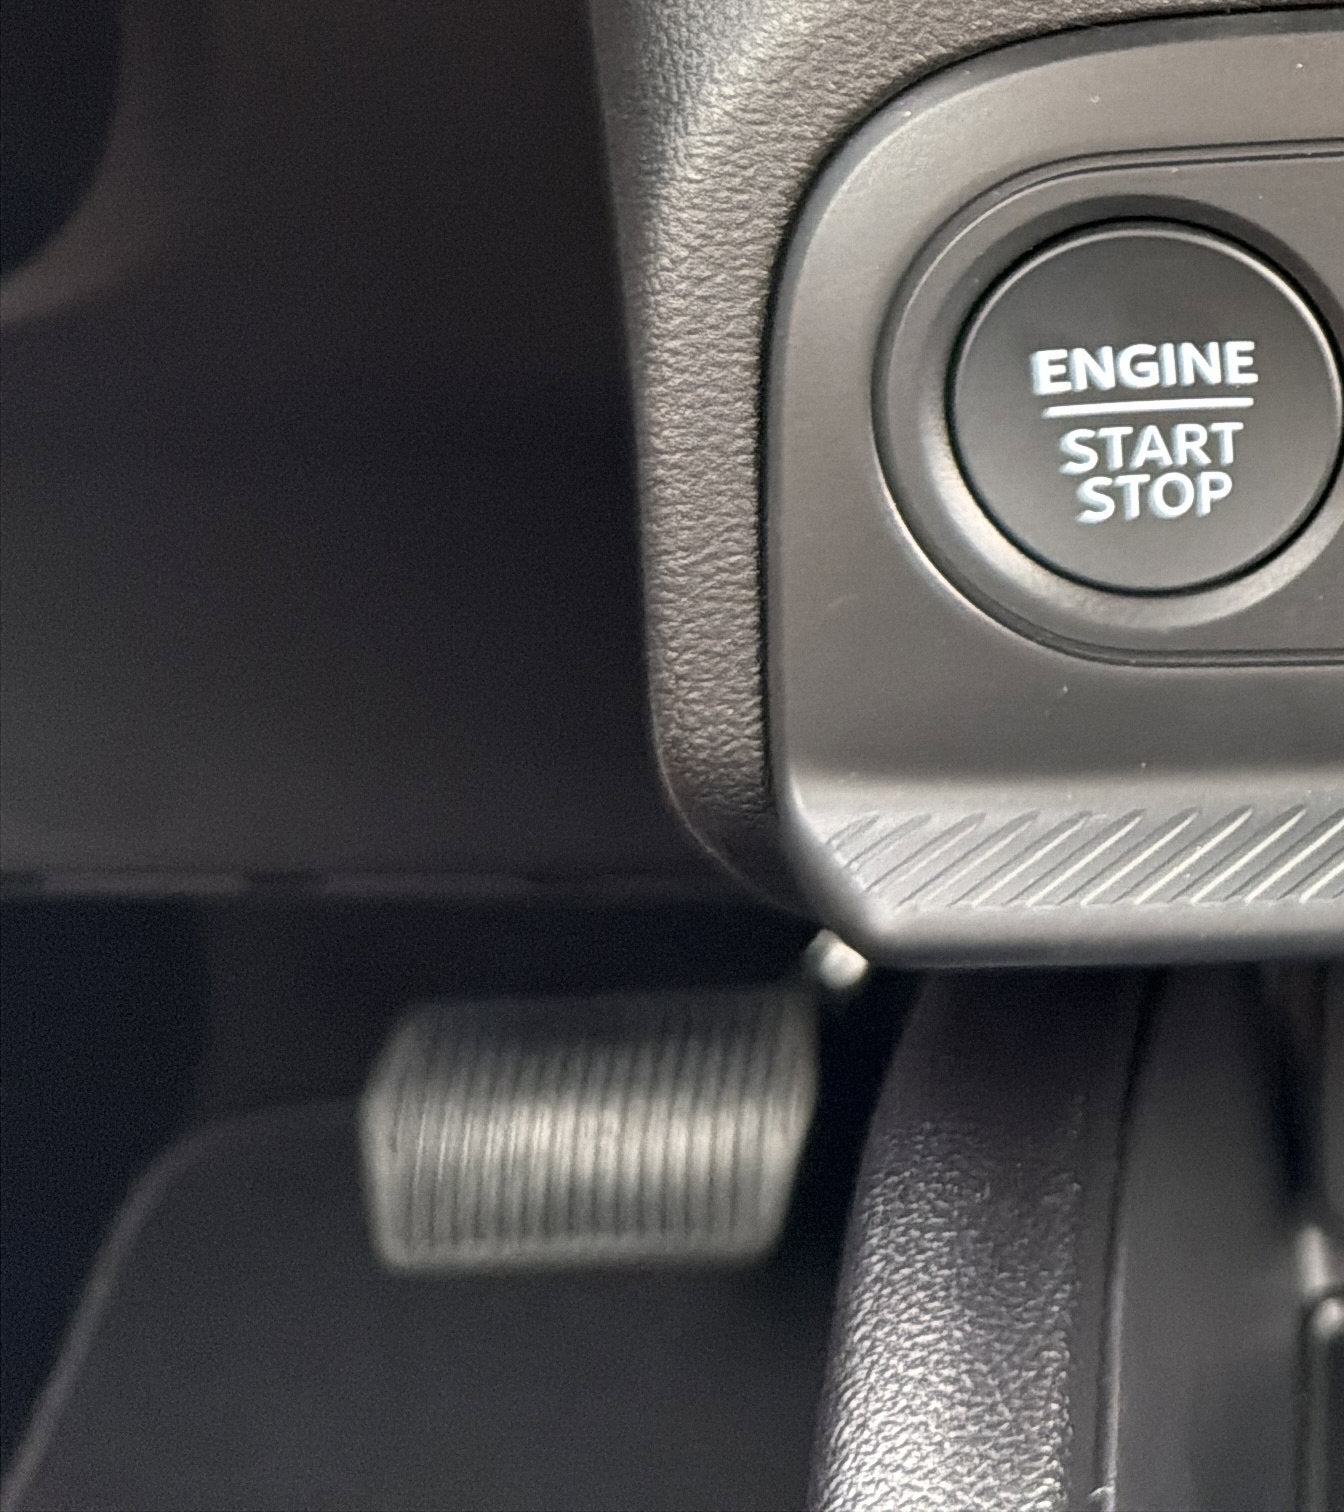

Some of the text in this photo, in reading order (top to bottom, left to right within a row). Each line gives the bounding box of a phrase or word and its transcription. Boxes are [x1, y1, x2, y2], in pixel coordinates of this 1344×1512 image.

[1031, 340, 1258, 395] ENGINE
[1059, 421, 1245, 477] START
[1075, 472, 1234, 524] STOP
